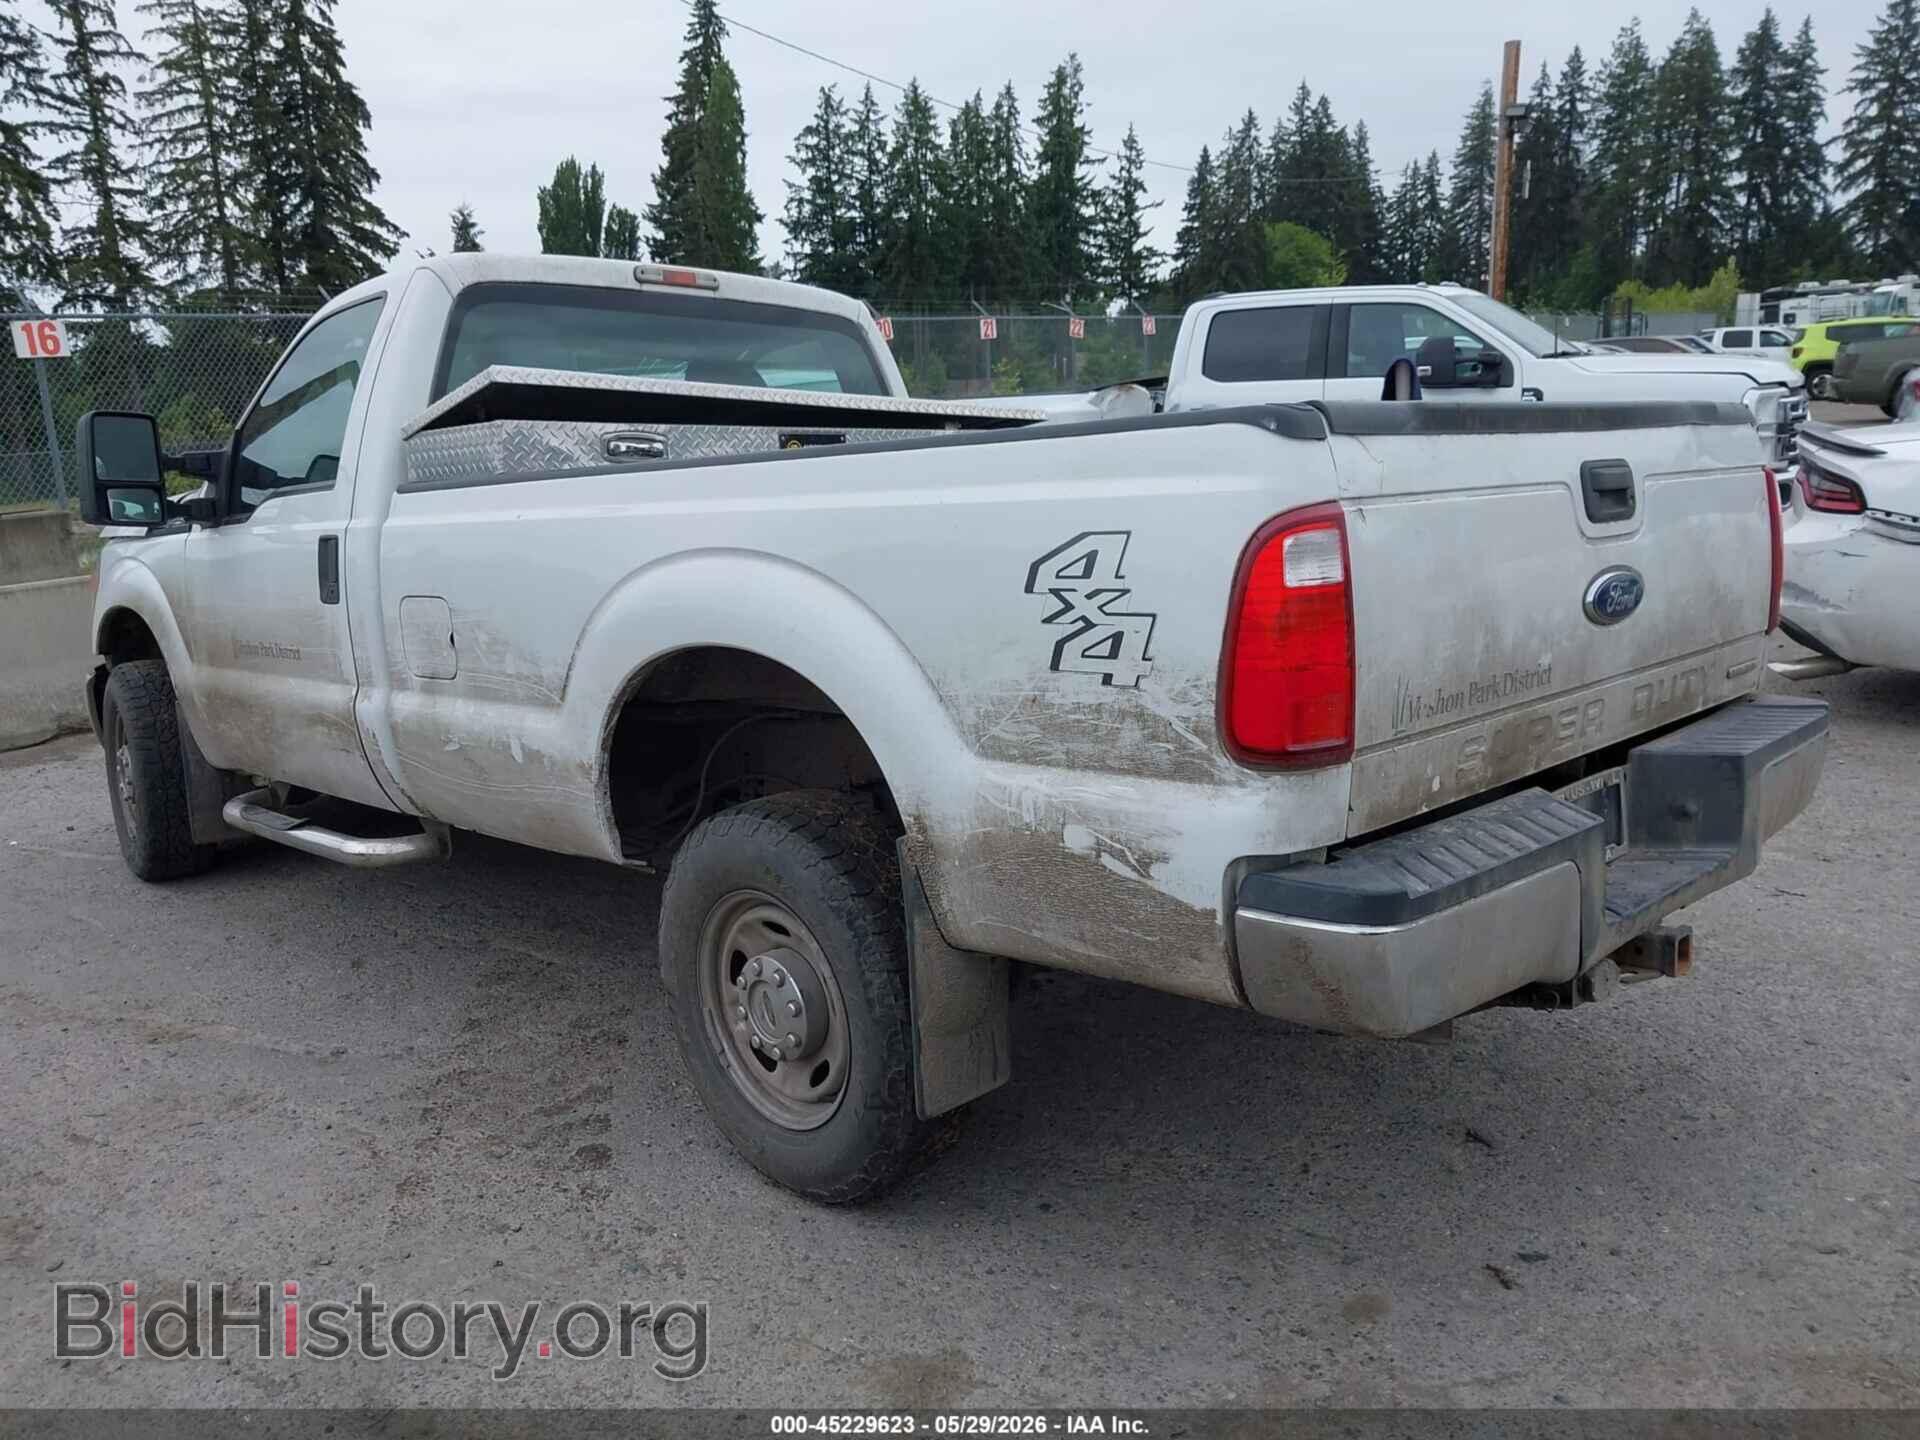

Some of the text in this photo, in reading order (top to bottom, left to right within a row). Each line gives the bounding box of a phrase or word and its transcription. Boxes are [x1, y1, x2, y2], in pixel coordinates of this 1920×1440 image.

[21, 322, 61, 356] 16
[982, 320, 994, 338] 21
[1071, 319, 1084, 336] 22
[1606, 582, 1638, 613] Ford
[1469, 674, 1500, 706] Park
[1503, 663, 1552, 697] District
